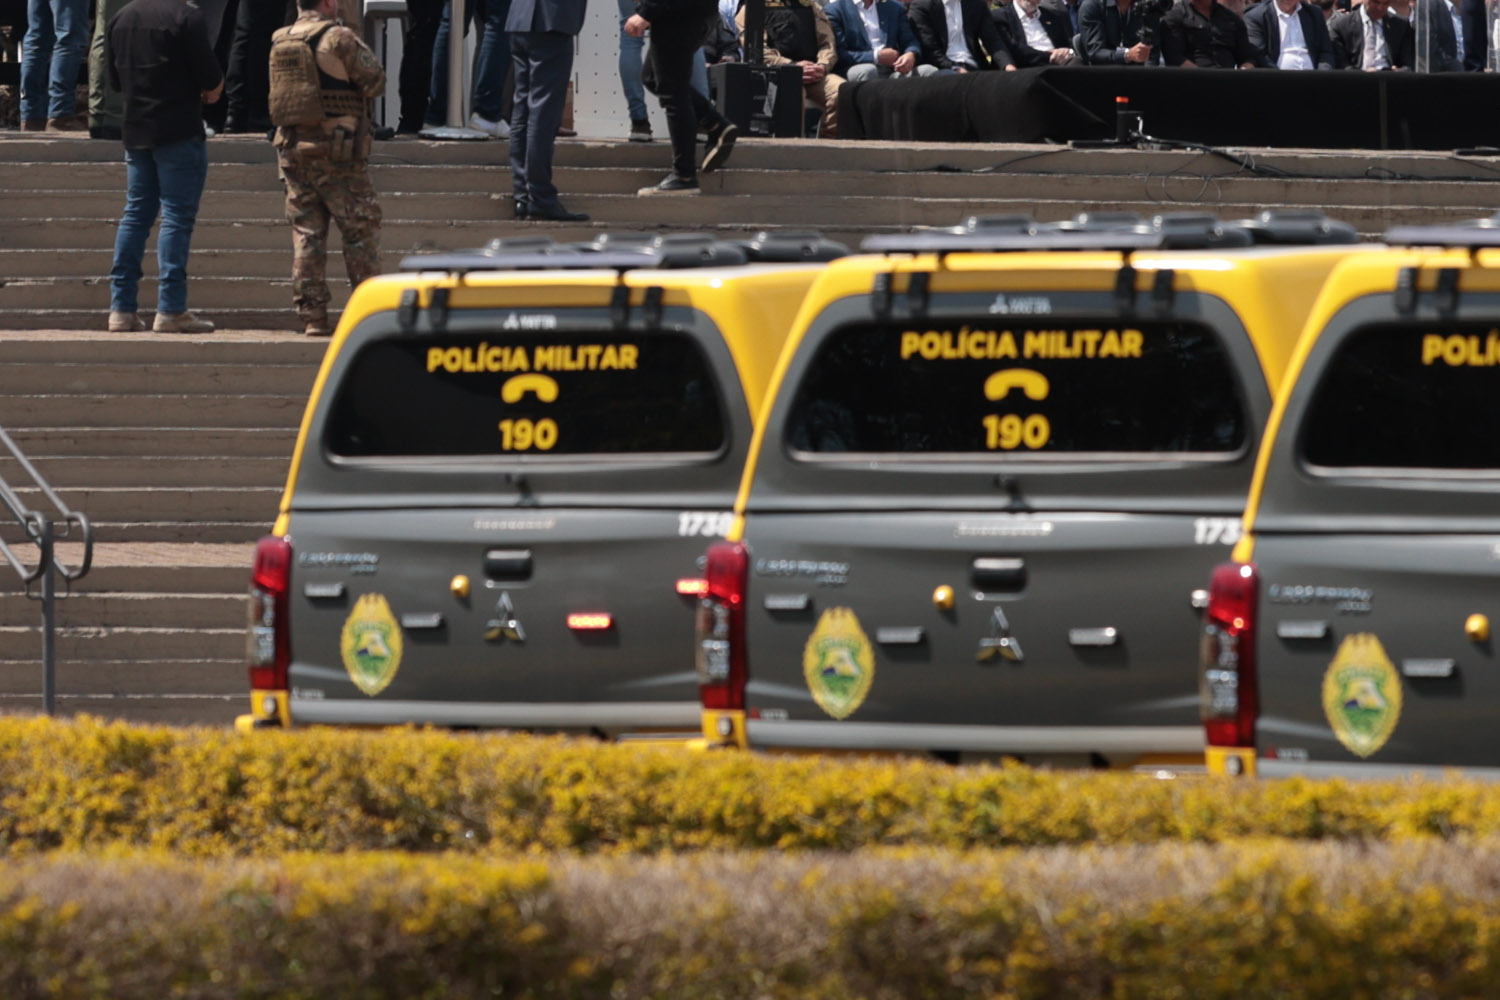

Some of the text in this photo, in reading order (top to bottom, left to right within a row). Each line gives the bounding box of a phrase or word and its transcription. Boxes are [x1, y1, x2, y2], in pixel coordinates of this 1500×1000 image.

[427, 342, 638, 373] POLÍCIA MILITAR
[901, 325, 1144, 360] POLÍCIA MILITAR
[499, 418, 558, 450] 190
[982, 413, 1050, 449] 190
